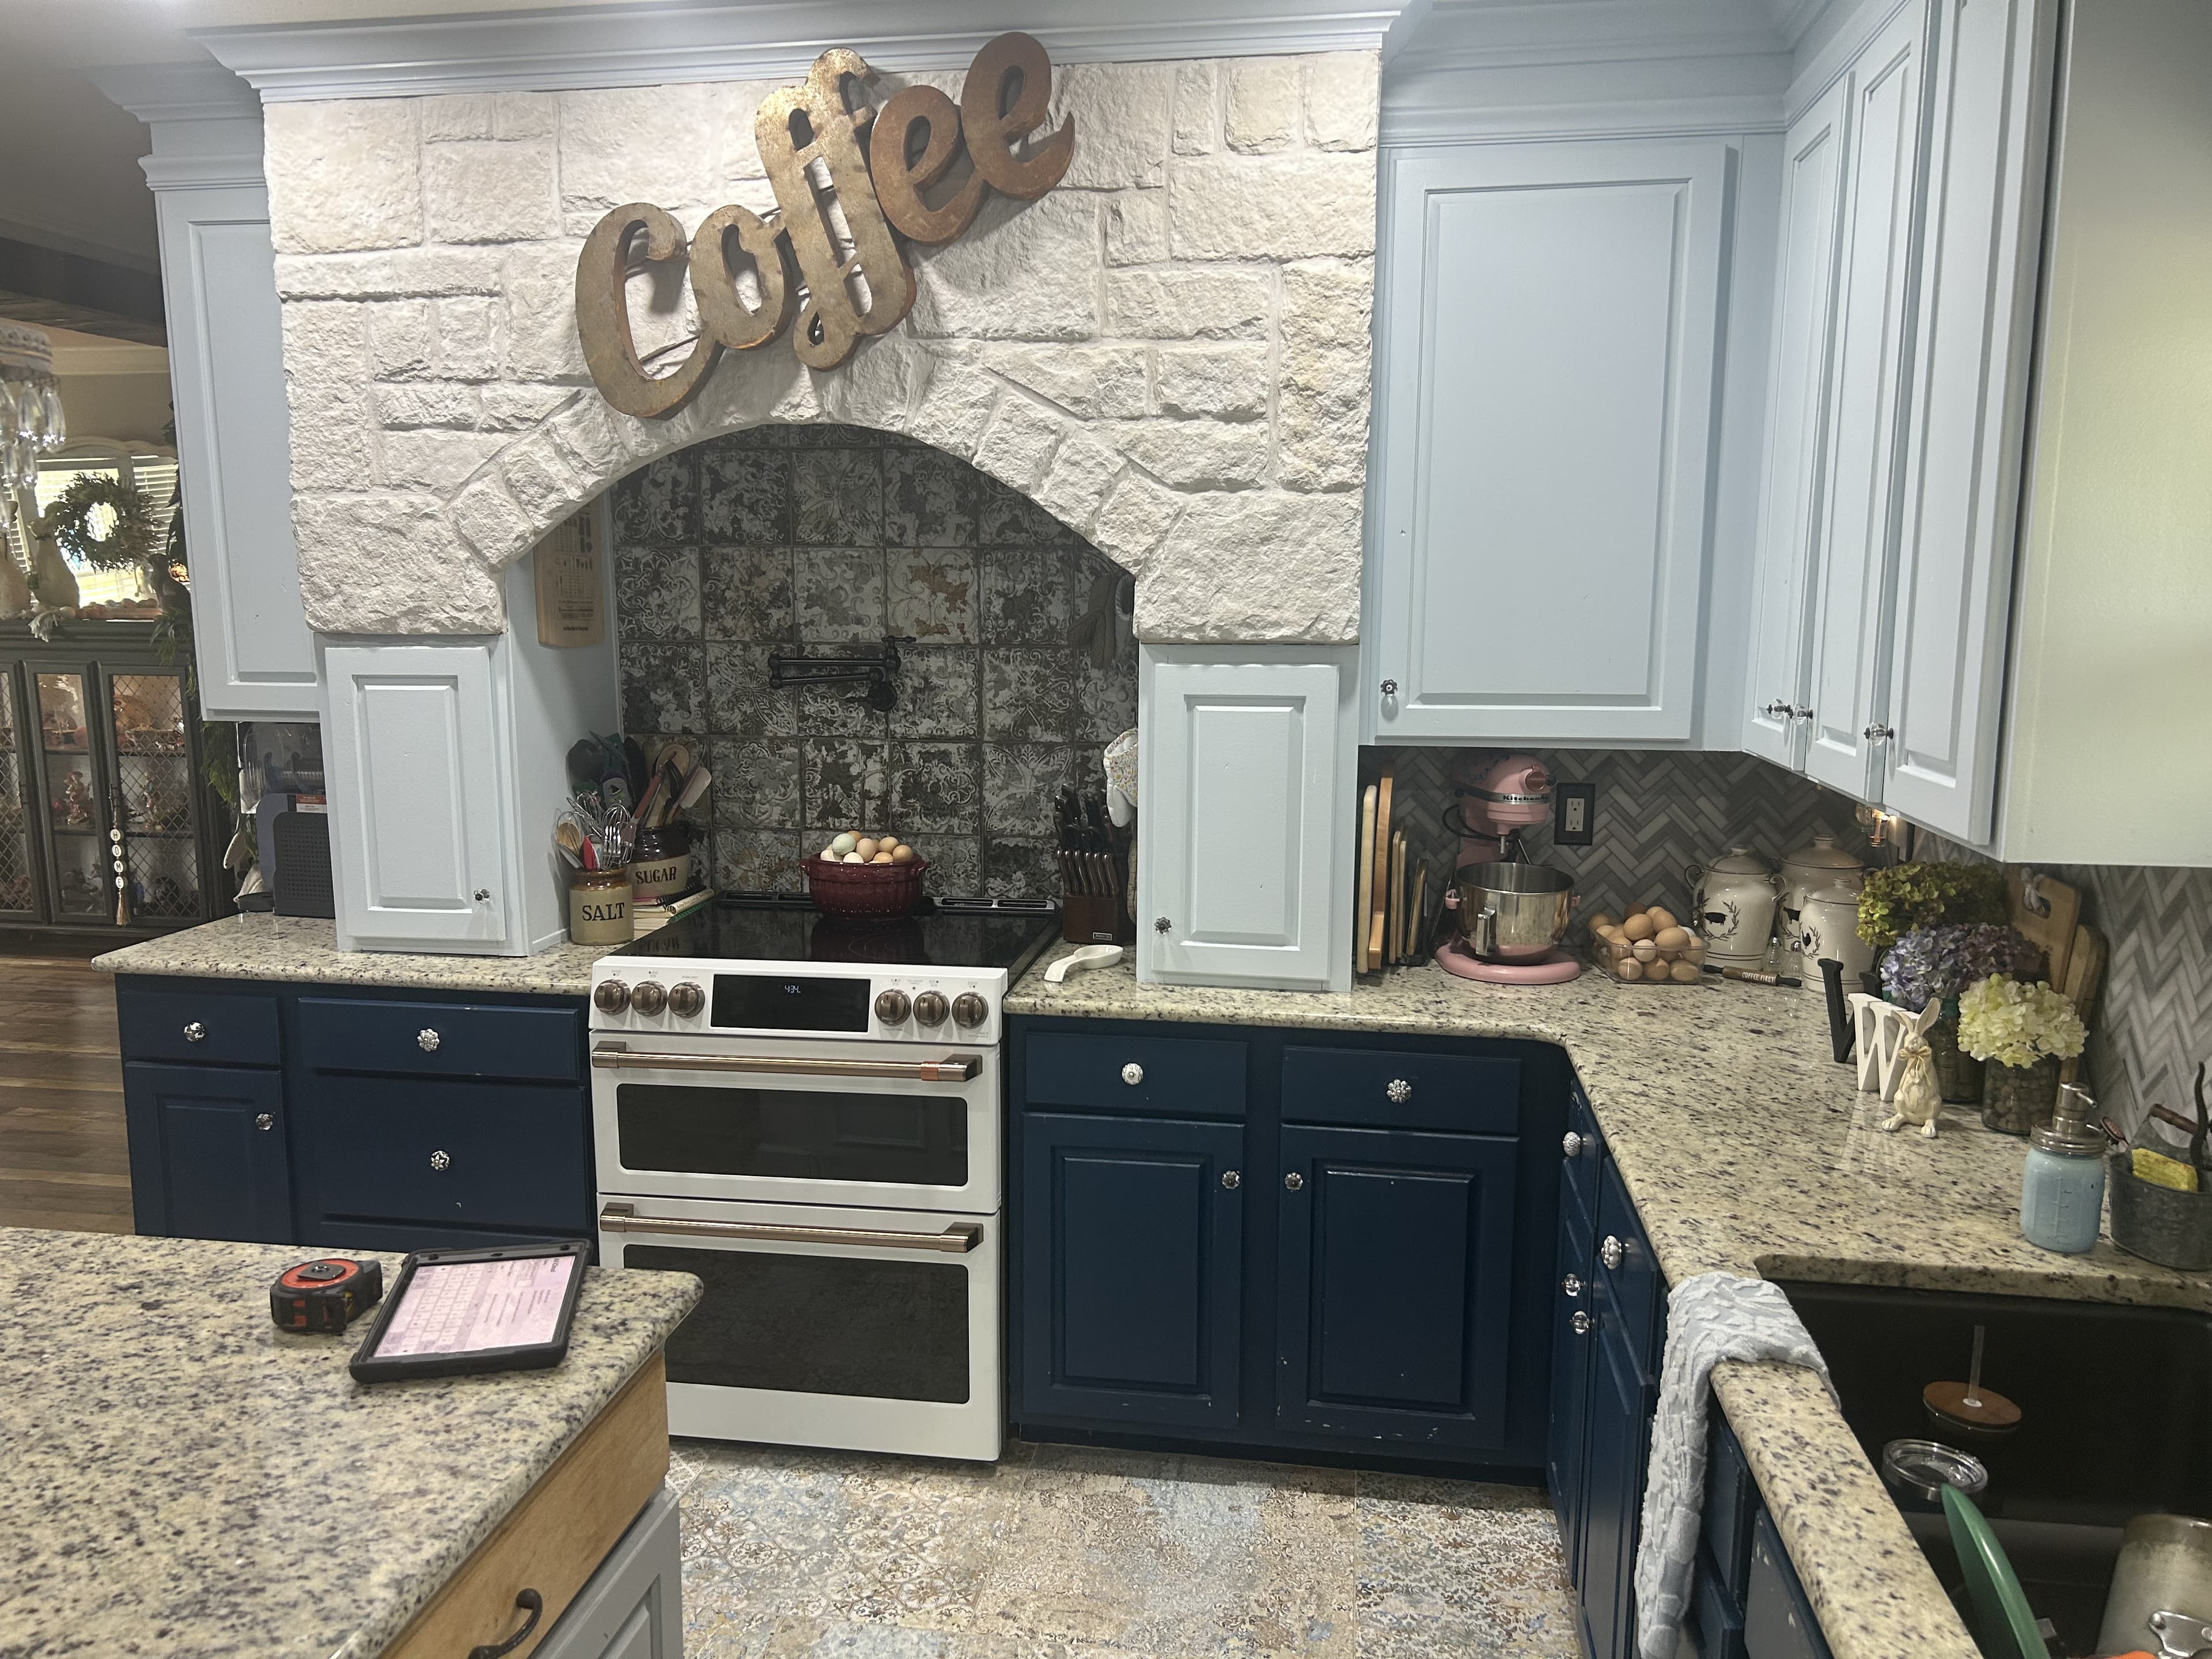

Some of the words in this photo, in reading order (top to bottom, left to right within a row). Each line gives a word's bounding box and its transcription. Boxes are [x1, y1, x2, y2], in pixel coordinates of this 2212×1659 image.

[112, 831, 123, 887] HOME
[635, 866, 677, 884] SUGAR
[582, 902, 625, 921] SALT
[1741, 971, 1760, 981] COFFEE
[1760, 975, 1774, 983] FIRST
